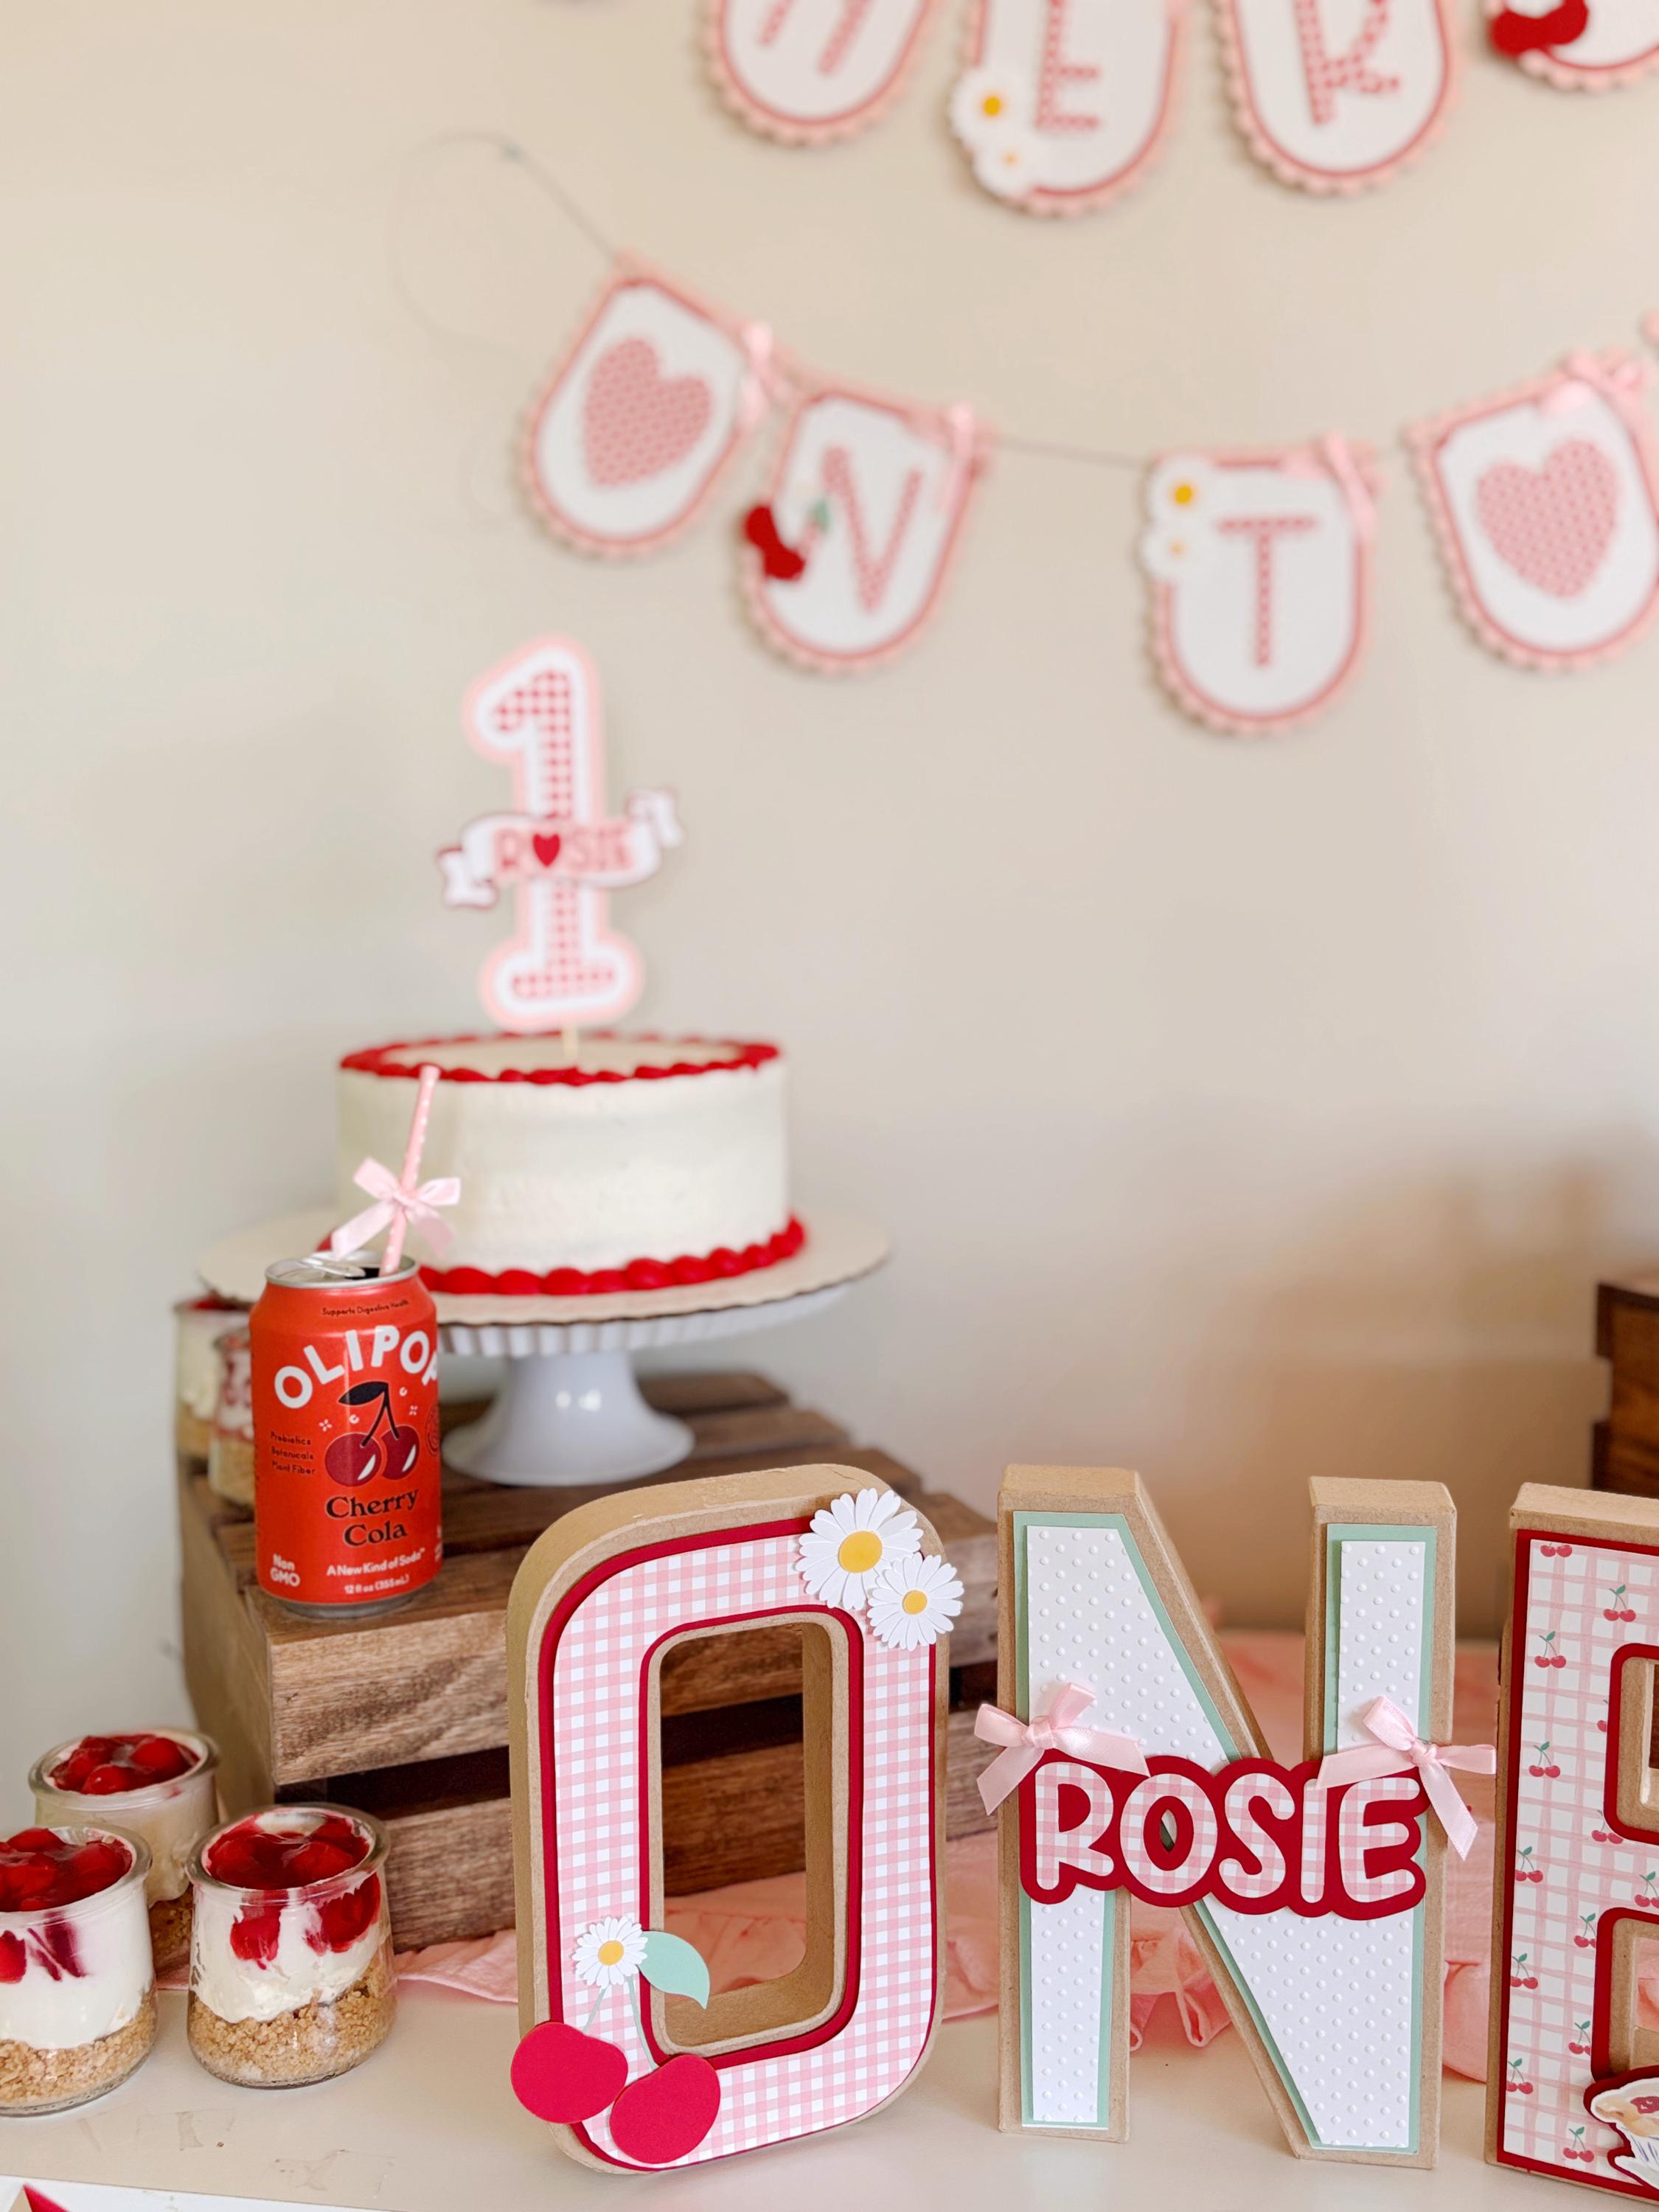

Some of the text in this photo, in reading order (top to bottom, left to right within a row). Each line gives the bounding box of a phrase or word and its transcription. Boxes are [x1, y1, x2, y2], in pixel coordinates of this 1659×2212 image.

[325, 1489, 420, 1519] Cherry
[343, 1520, 408, 1547] Cola
[273, 1553, 296, 1572] Non
[326, 1564, 336, 1576] A
[336, 1564, 362, 1576] New
[363, 1559, 387, 1574] Kind
[387, 1556, 399, 1570] of
[269, 1566, 302, 1587] GMO
[344, 1585, 355, 1595] 12
[1034, 1761, 1421, 1904] ROSIE
